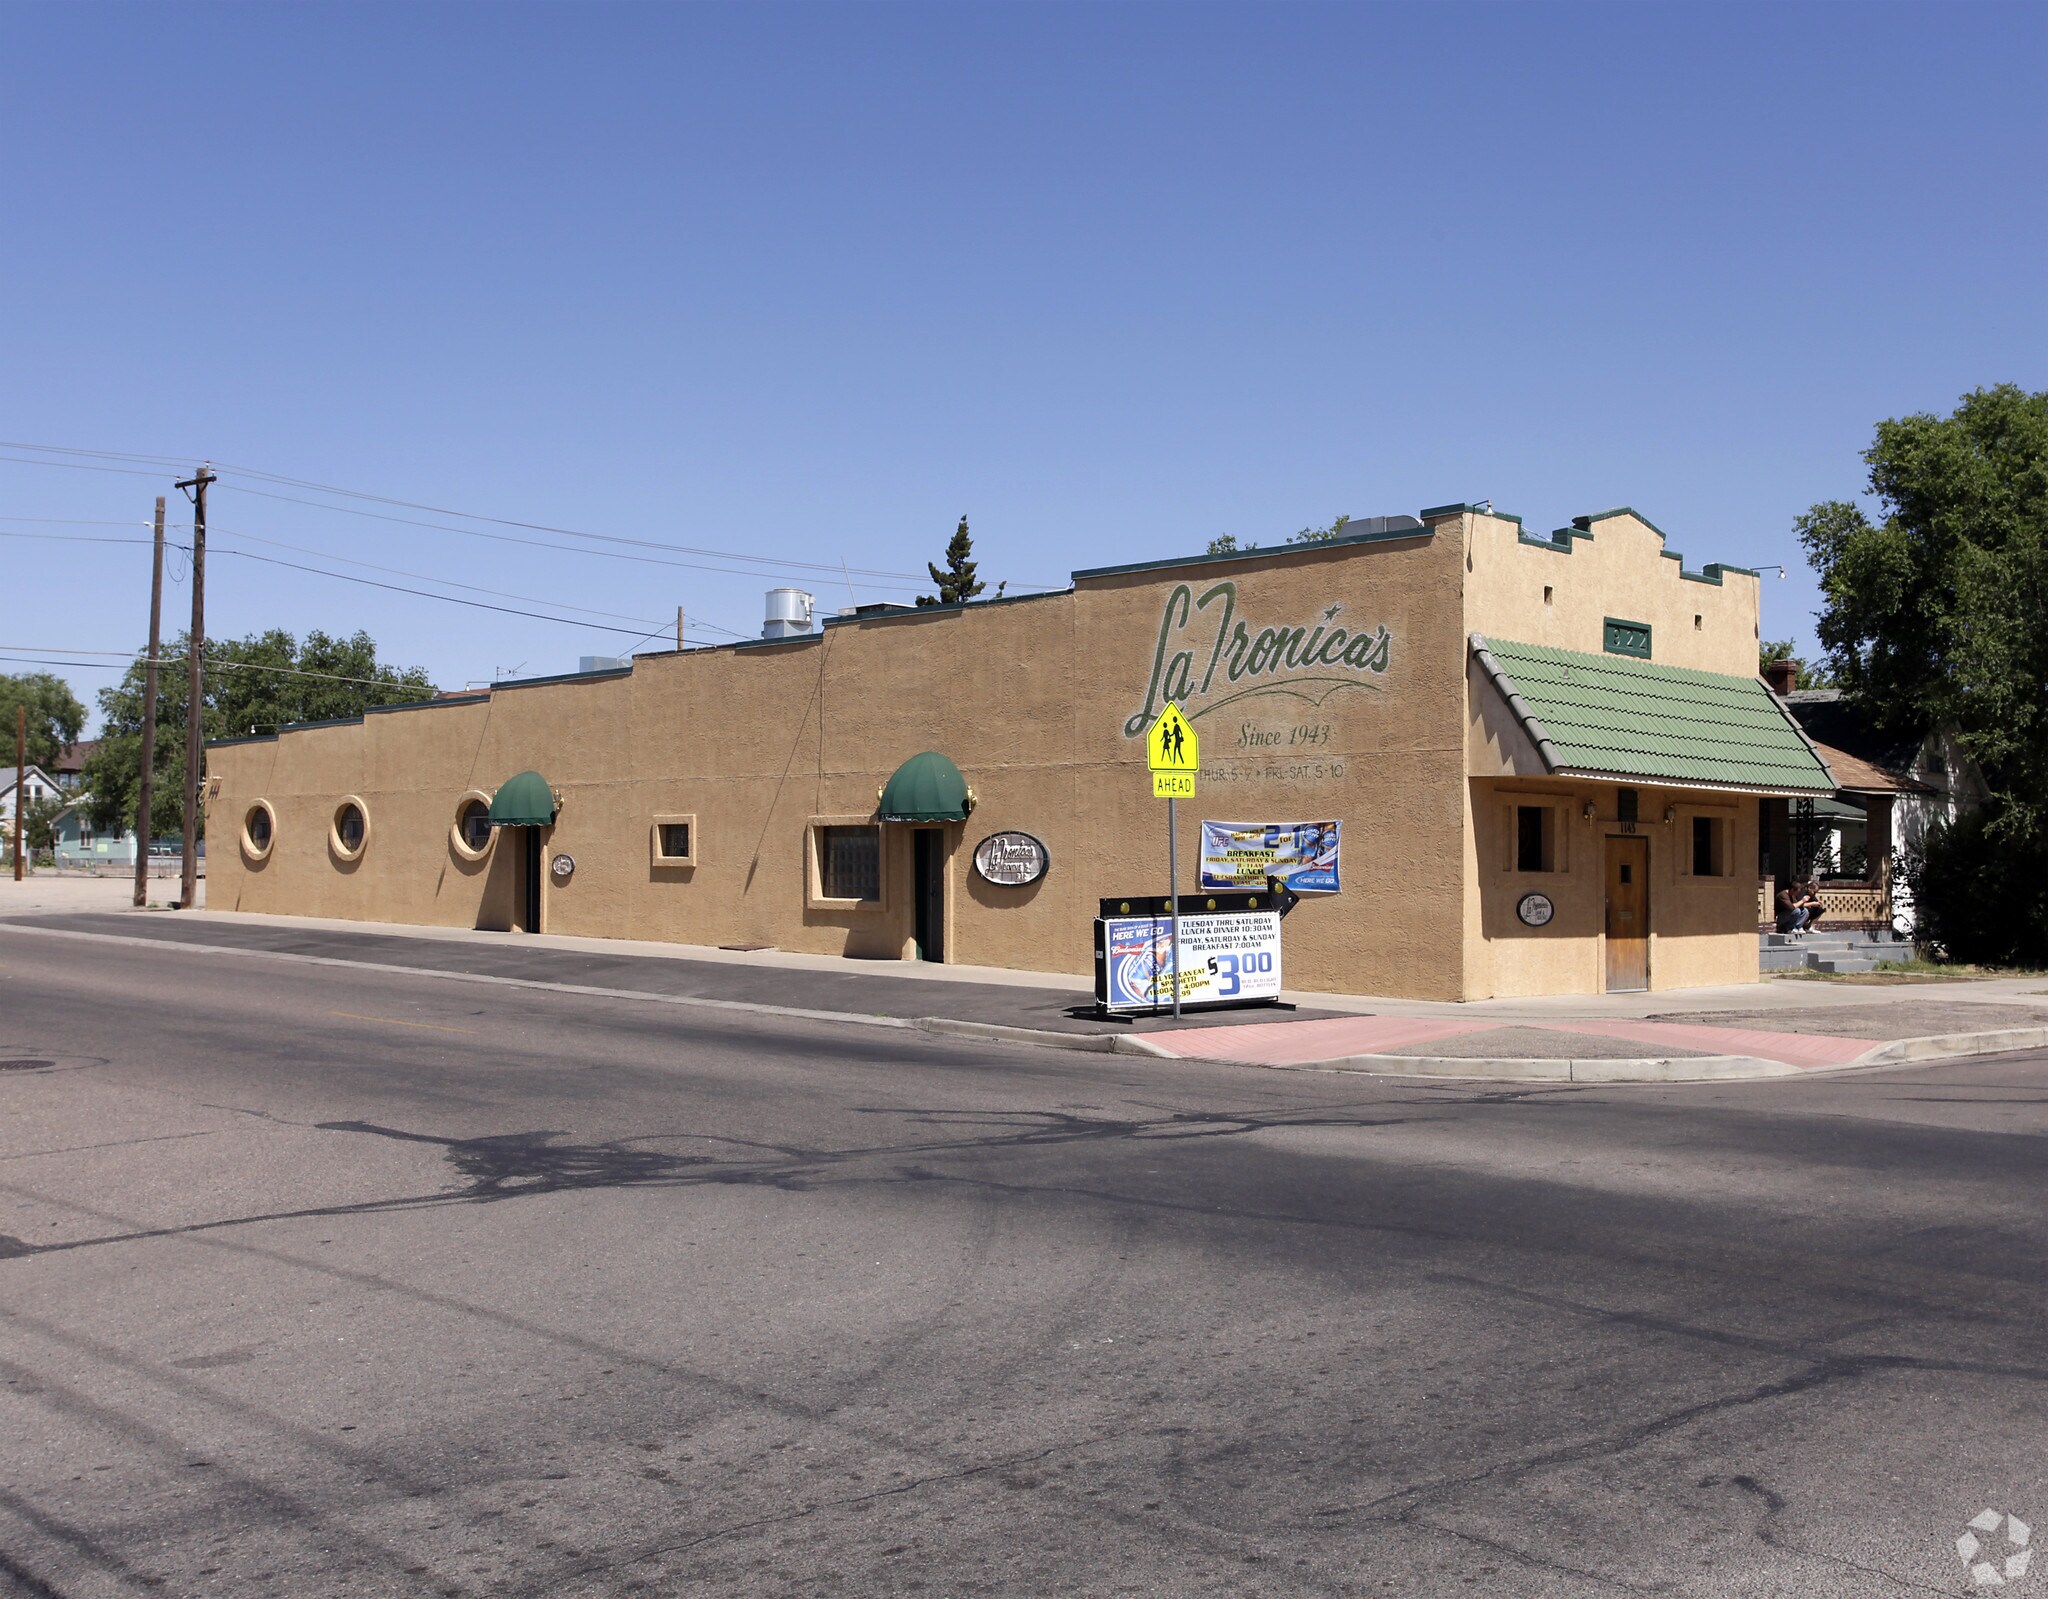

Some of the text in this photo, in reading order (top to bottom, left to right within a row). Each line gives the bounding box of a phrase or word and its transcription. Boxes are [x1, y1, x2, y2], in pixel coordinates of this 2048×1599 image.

[1123, 581, 1391, 739] La Tronica's
[1236, 722, 1330, 748] Since 1943
[1157, 777, 1191, 793] AHEAD
[1212, 836, 1229, 847] UFC
[1264, 825, 1300, 848] 2 for 1
[1182, 920, 1214, 928] TUESDAY
[1236, 917, 1272, 925] SATURDAY
[1112, 930, 1135, 941] HERE
[1136, 928, 1150, 938] WE
[1150, 926, 1164, 936] GO
[1181, 928, 1205, 936] LUNCH
[1213, 926, 1240, 934] DINNER
[1205, 935, 1241, 943] SATURDAY
[1249, 933, 1276, 941] SUNDAY
[1192, 941, 1262, 951] BREAKFAST 7:00AM
[1151, 975, 1163, 983] ALL
[1178, 970, 1193, 978] CAN
[1160, 976, 1197, 987] SPAHETTI
[1149, 987, 1174, 996] 11:00A
[1183, 980, 1210, 989] 4:00PM
